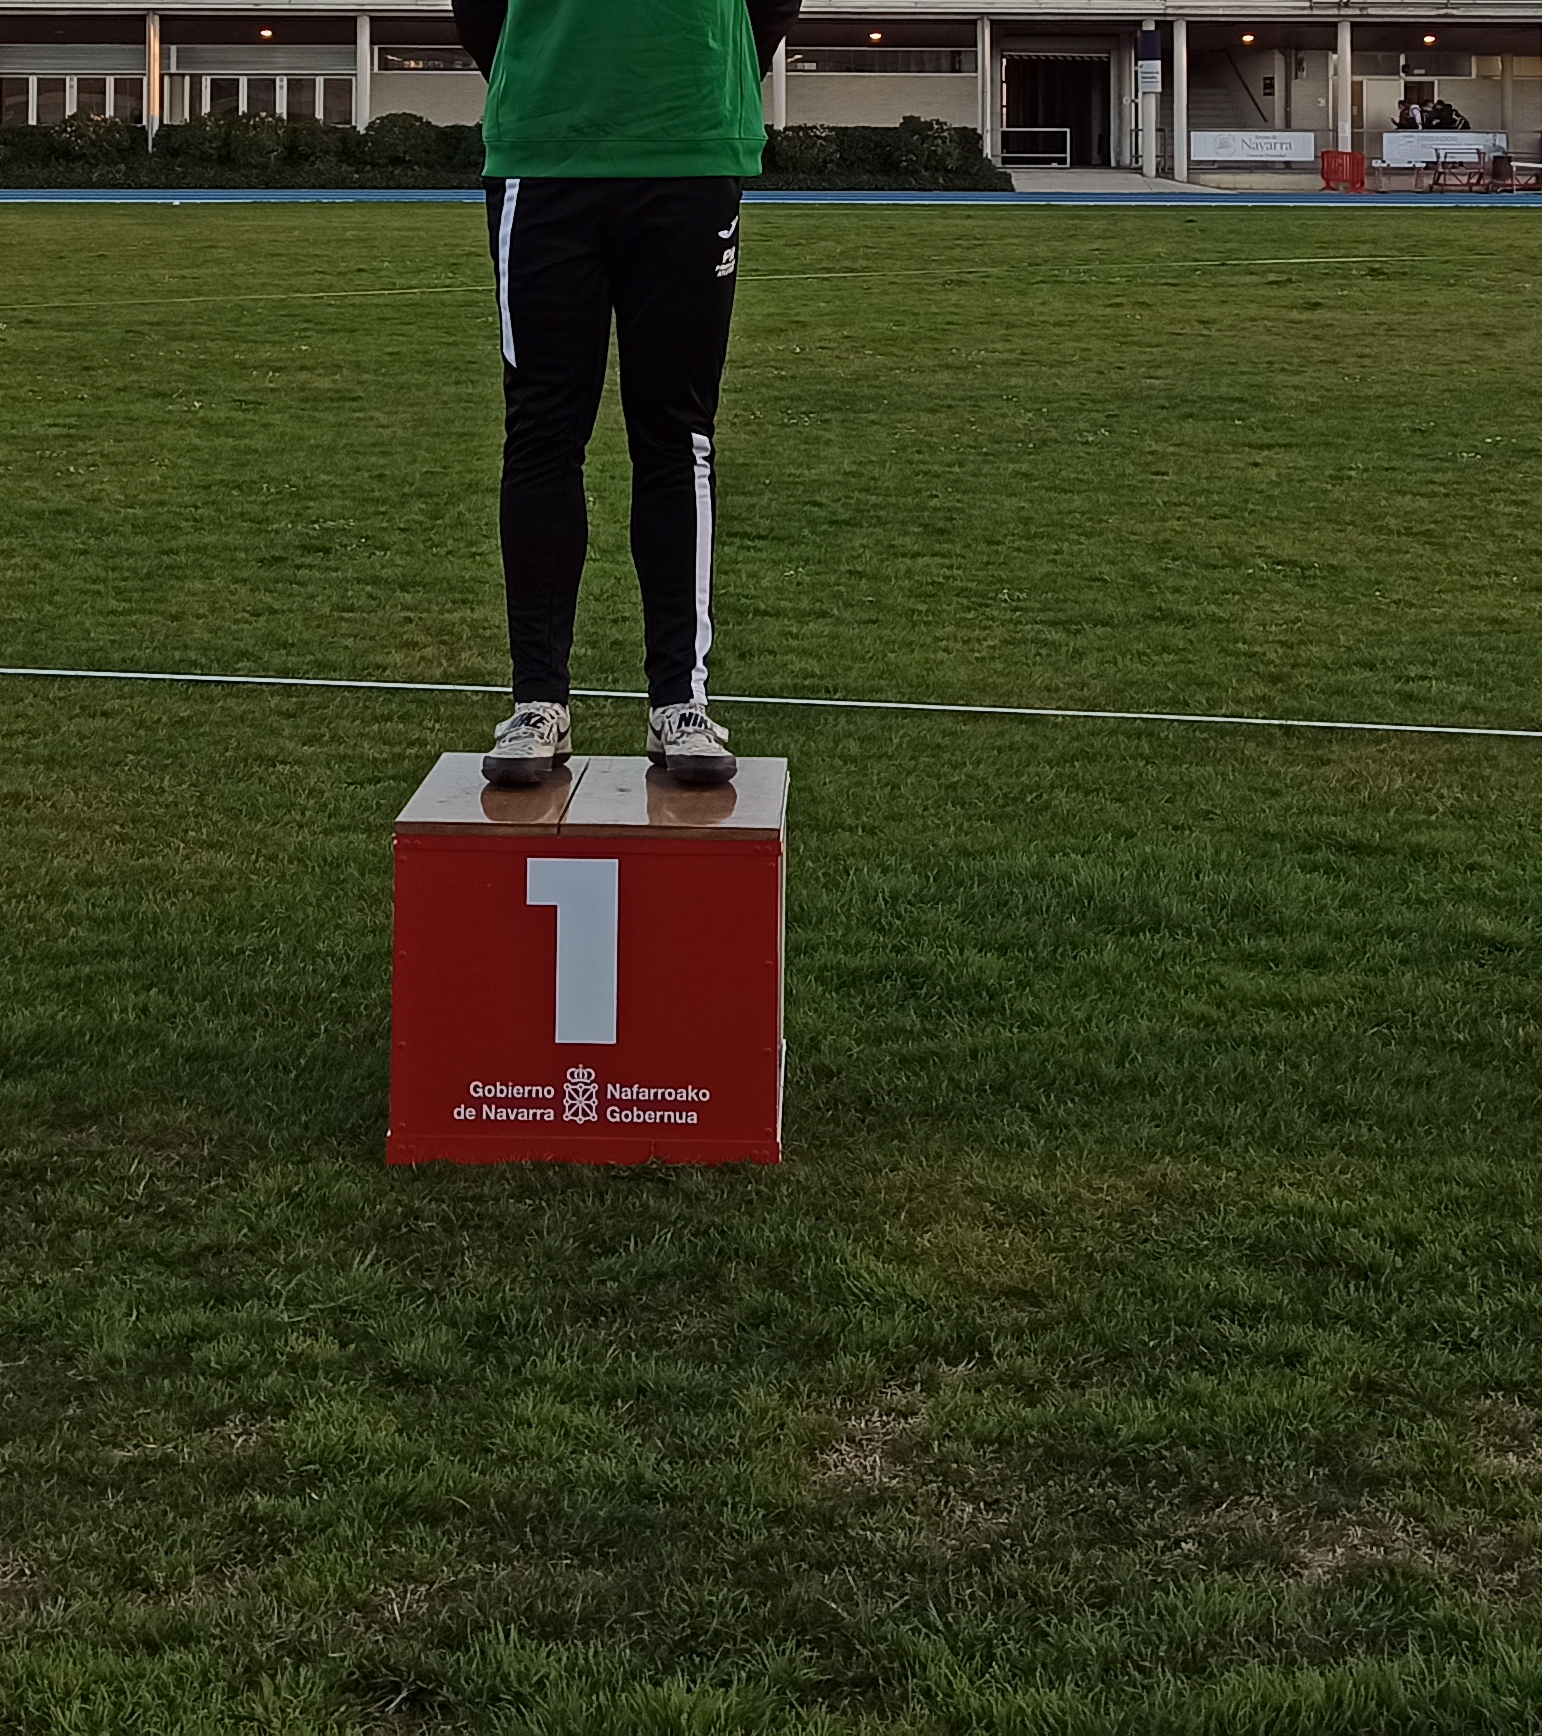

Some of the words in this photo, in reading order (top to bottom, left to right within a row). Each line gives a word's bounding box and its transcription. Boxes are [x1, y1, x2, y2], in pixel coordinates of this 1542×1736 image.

[1241, 138, 1293, 151] Navarra
[527, 858, 619, 1044] 1
[469, 1081, 555, 1099] Gobierno
[607, 1083, 710, 1102] Nafarroako
[453, 1104, 476, 1121] de
[481, 1104, 555, 1121] Navarra
[606, 1105, 698, 1124] Gobernua
